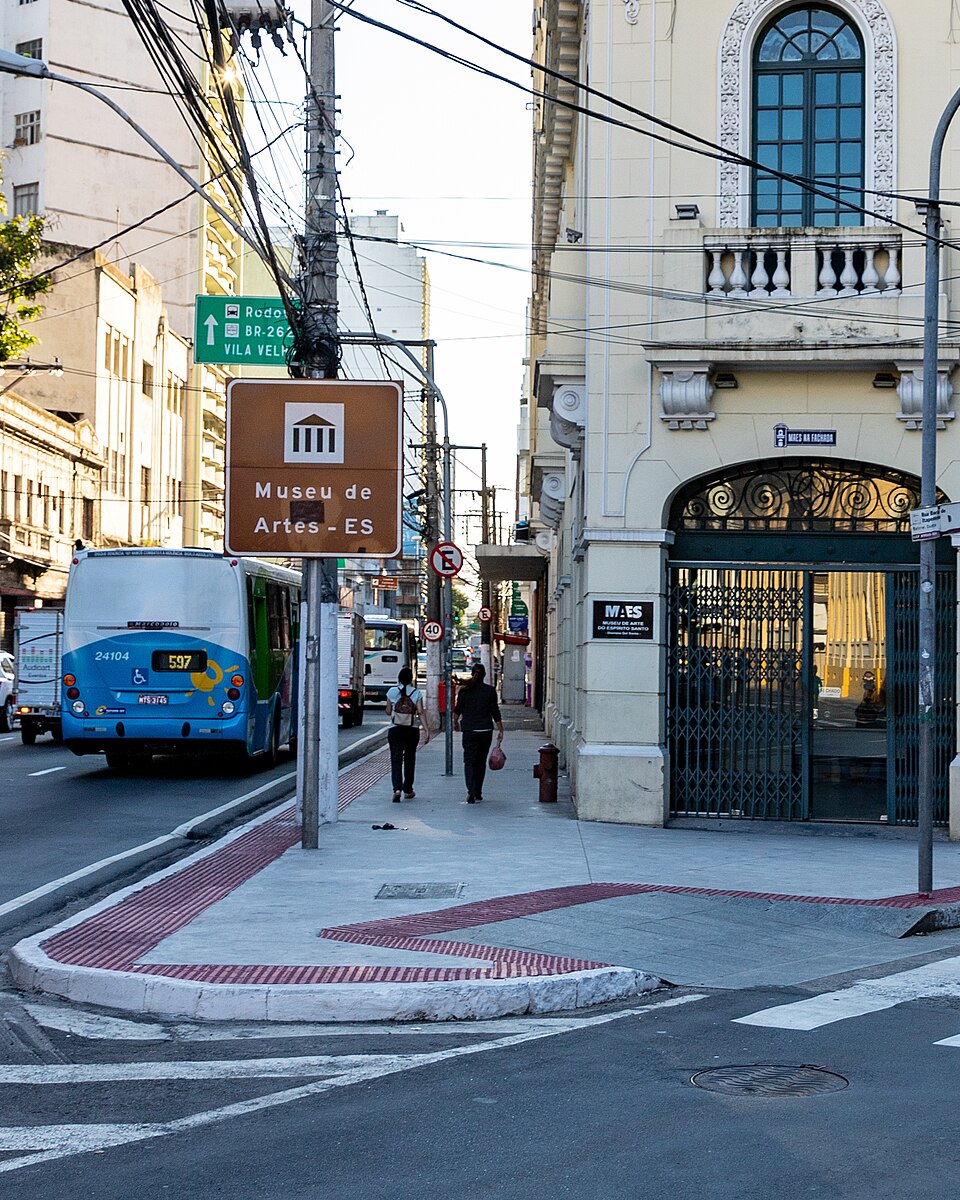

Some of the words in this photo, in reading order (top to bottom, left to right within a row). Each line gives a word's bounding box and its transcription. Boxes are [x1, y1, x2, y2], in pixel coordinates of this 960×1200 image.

[245, 325, 295, 338] BR-262
[224, 343, 252, 356] VILA
[257, 344, 296, 357] VELH
[255, 482, 332, 500] Museu
[345, 484, 372, 501] de
[254, 518, 319, 534] Artes
[345, 518, 374, 535] ES
[605, 604, 643, 619] MAES
[426, 625, 440, 635] 40
[95, 651, 130, 661] 24104
[168, 655, 192, 669] 597
